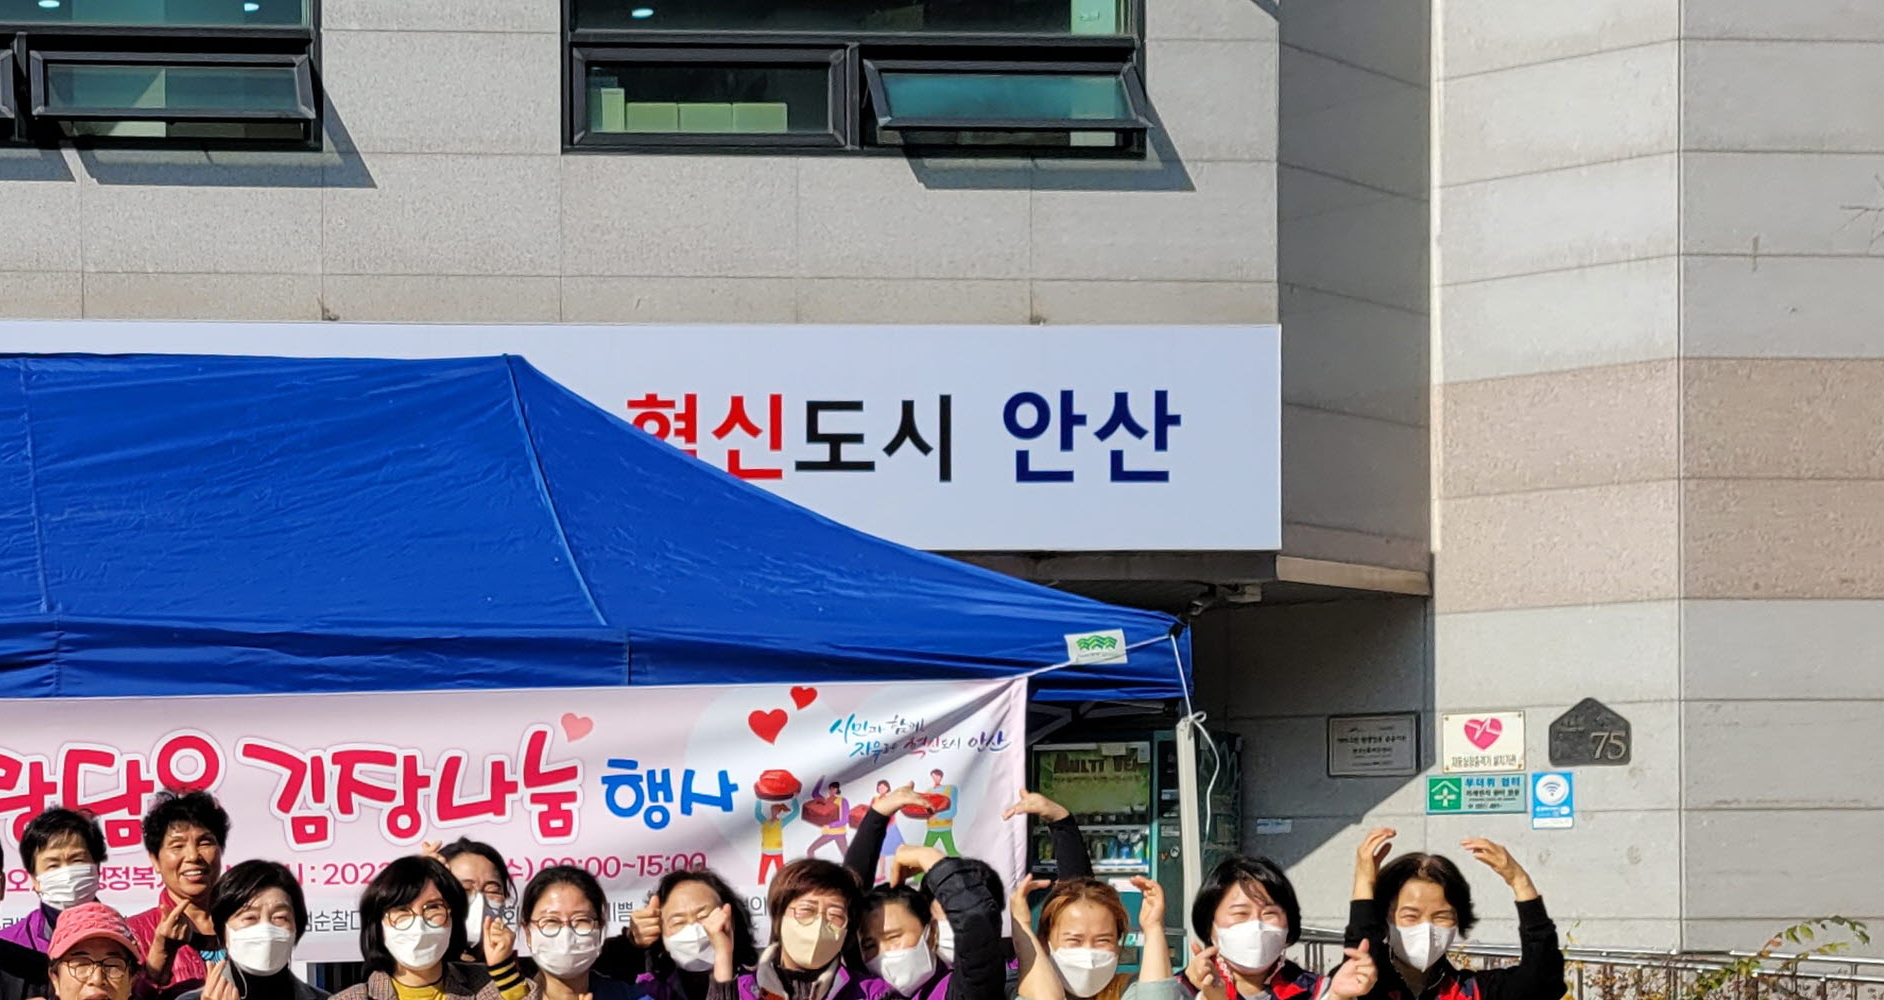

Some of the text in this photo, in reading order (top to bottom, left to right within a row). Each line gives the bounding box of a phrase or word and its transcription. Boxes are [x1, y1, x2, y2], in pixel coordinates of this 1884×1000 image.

[1003, 389, 1182, 483] 안산
[968, 731, 1011, 751] 안산
[1590, 731, 1627, 760] 75
[241, 729, 579, 845] 김장나눔
[601, 758, 739, 831] 행사
